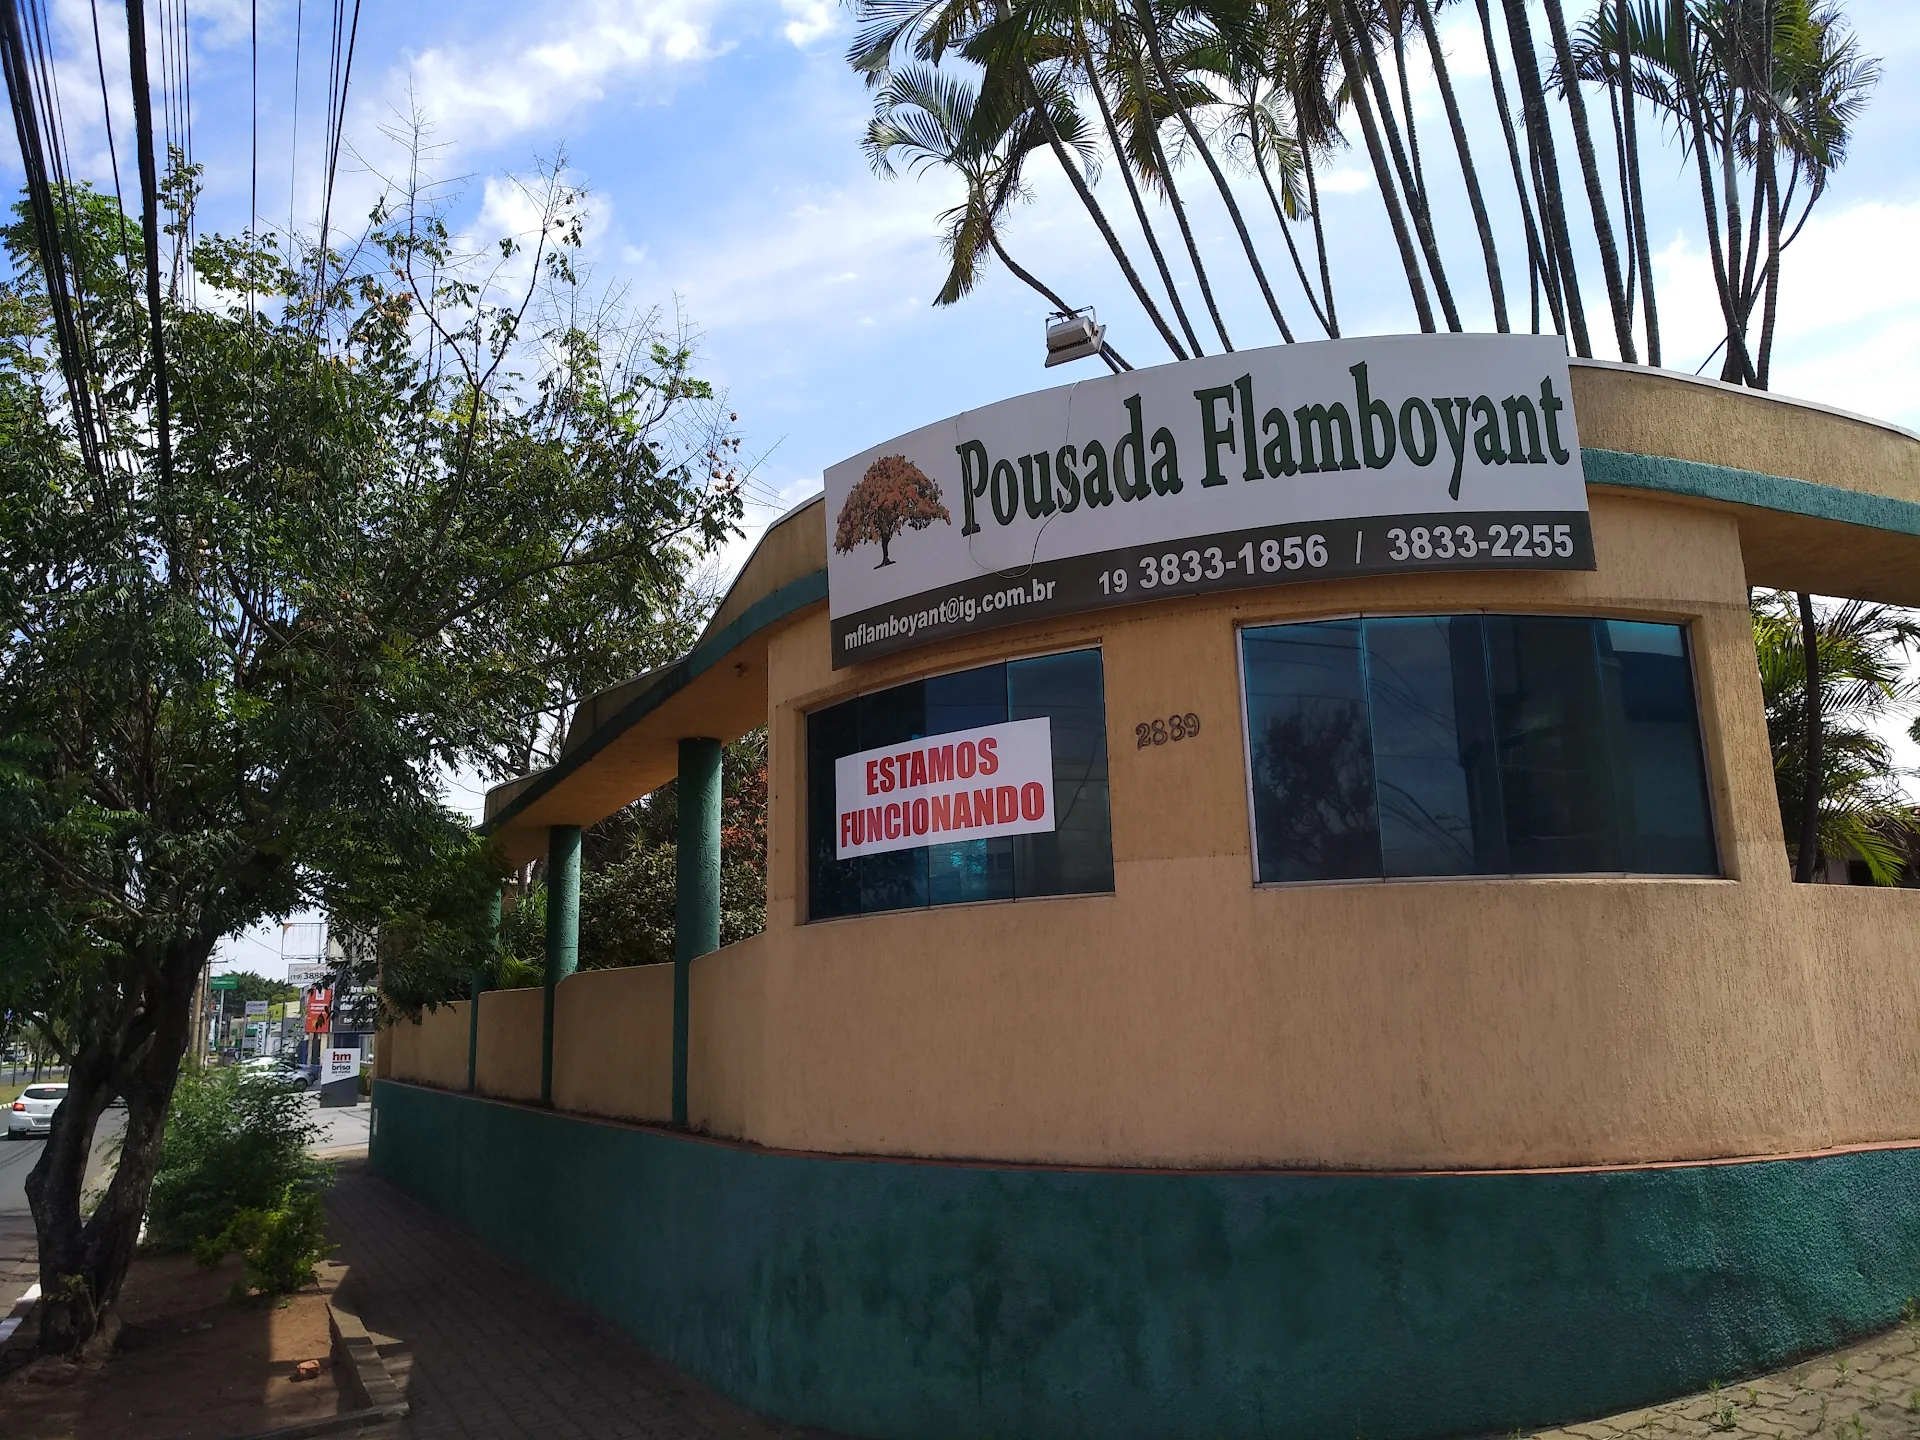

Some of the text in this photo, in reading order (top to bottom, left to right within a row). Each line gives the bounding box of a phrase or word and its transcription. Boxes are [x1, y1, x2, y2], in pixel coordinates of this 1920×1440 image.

[955, 360, 1570, 537] Pousada Flamboyant
[1098, 568, 1128, 595] 19
[1139, 534, 1329, 589] 3833-1856
[1386, 524, 1574, 561] 3833-2255
[844, 578, 1056, 651] mflamboyant@ig.com.br
[1135, 712, 1201, 751] 2889
[866, 737, 999, 796] ESTAMOS
[841, 782, 1045, 848] FUNCIONANDO
[333, 1051, 351, 1060] hm
